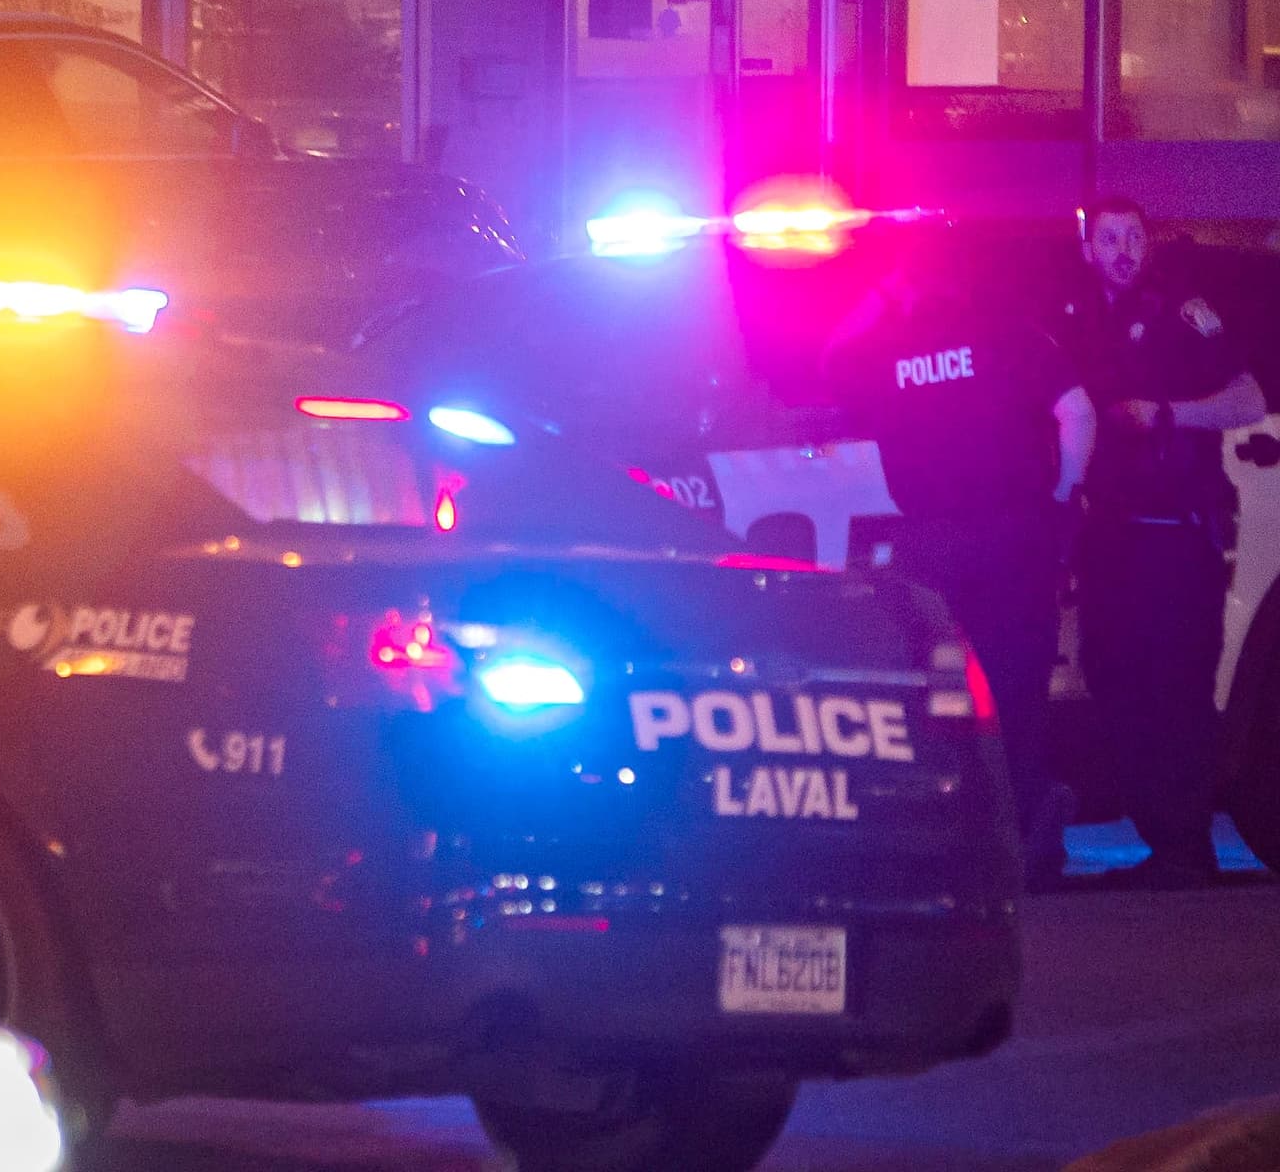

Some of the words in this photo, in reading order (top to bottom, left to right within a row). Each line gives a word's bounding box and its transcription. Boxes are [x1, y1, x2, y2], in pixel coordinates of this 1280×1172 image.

[897, 346, 975, 389] POLICE
[69, 606, 197, 654] POLICE
[629, 690, 915, 762] POLICE
[223, 731, 287, 775] 911
[714, 765, 859, 820] LAVAL
